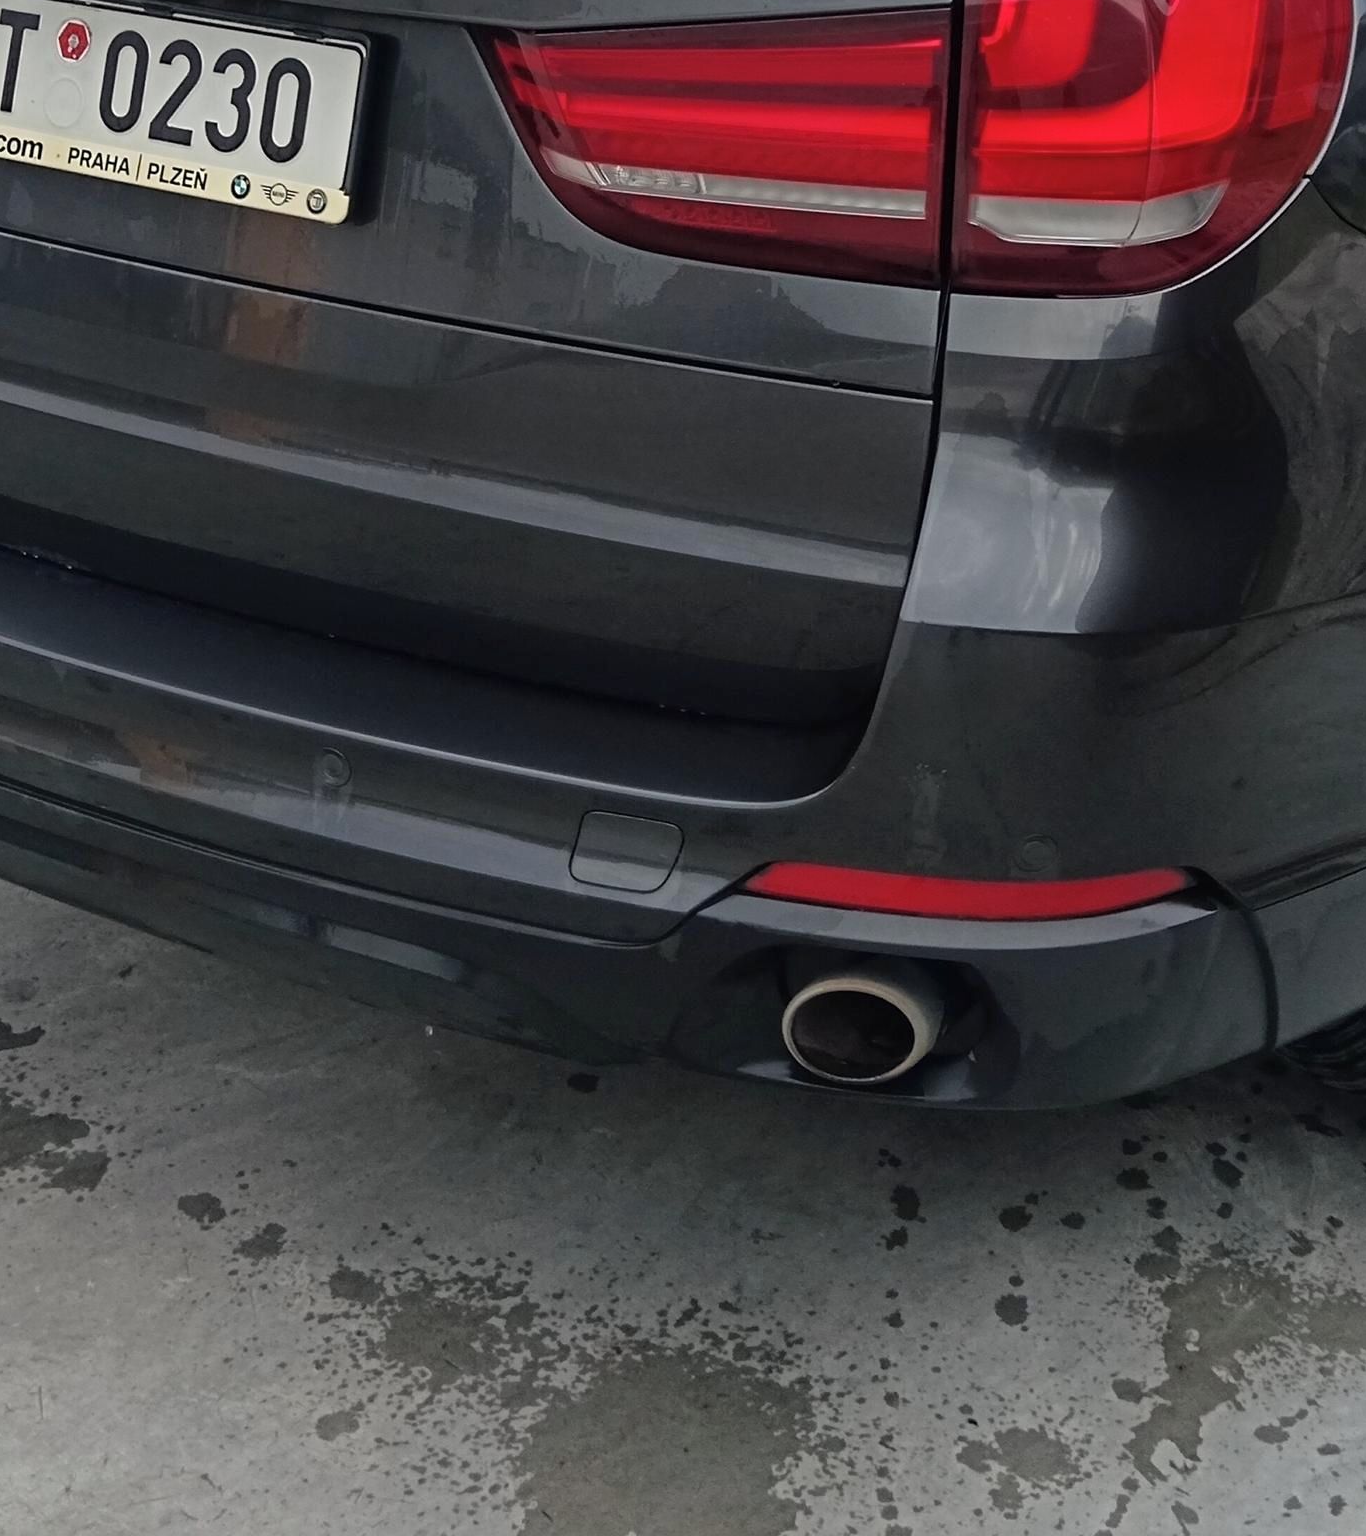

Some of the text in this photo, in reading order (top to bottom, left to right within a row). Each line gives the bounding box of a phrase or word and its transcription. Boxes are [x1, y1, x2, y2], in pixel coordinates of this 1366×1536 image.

[98, 30, 312, 164] 0230
[67, 147, 131, 176] PRAHA
[146, 162, 208, 191] PLZEŇ
